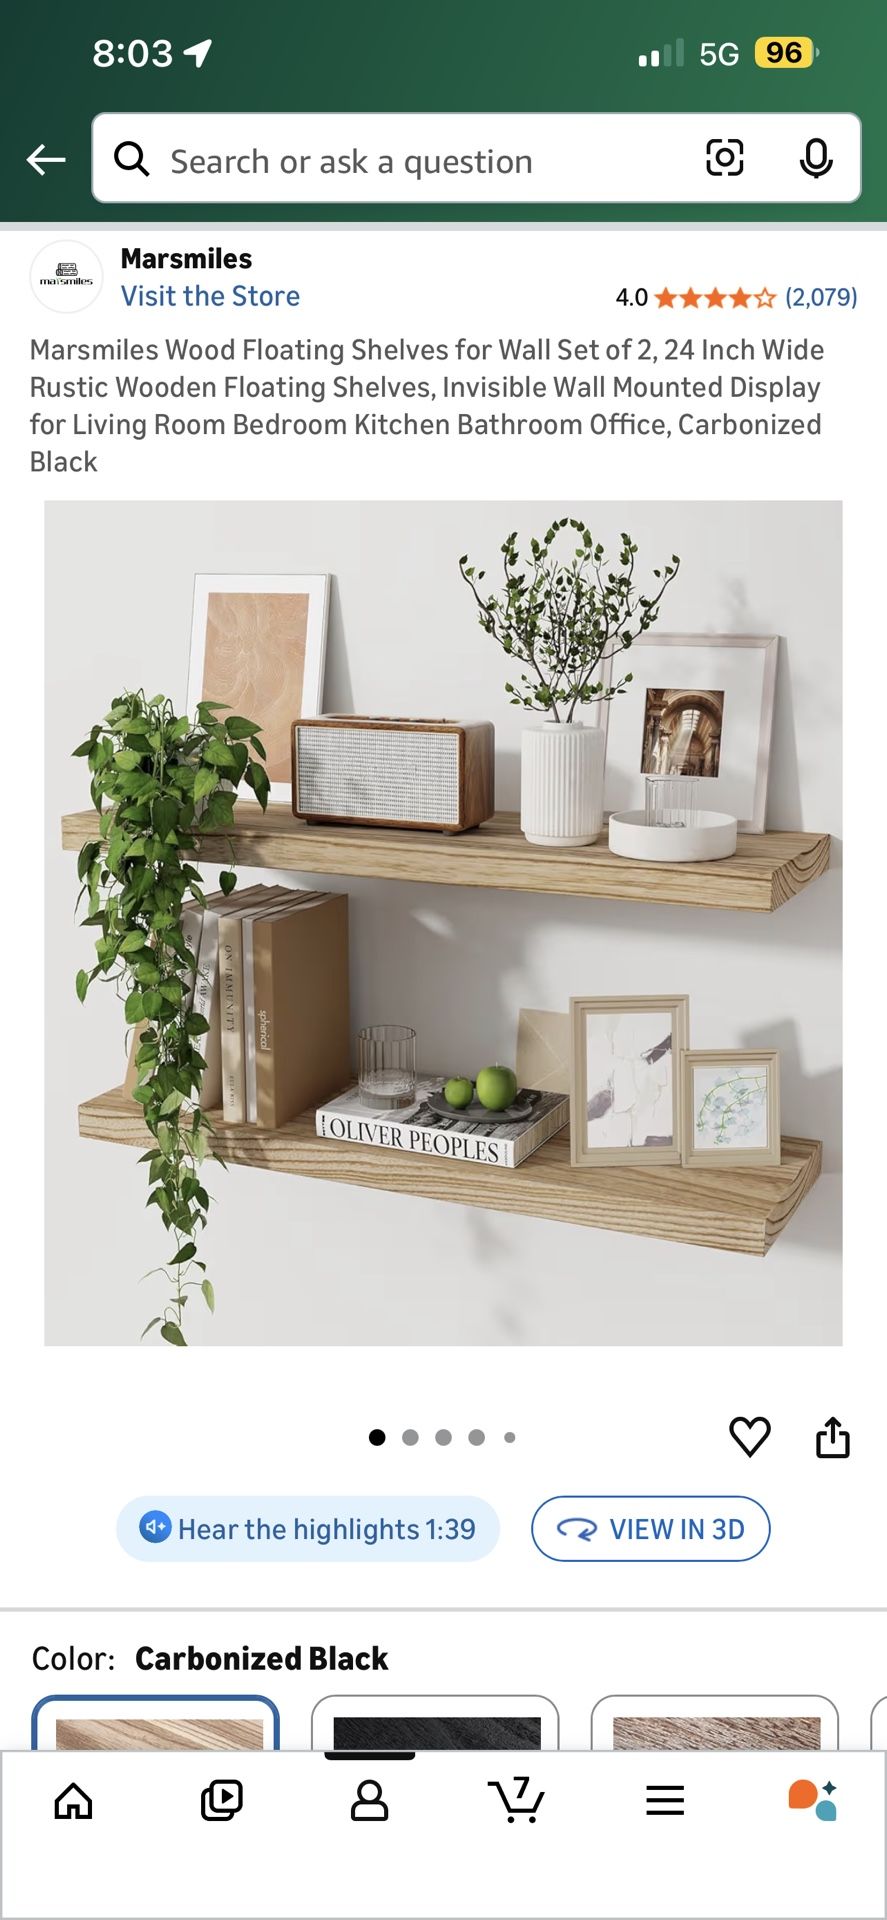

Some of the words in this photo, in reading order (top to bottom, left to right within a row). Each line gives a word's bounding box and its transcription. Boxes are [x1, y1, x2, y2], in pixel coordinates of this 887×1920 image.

[93, 39, 172, 67] 8:03
[700, 41, 740, 67] 5G
[765, 41, 803, 64] 96
[171, 147, 269, 175] Search
[280, 154, 312, 175] or
[320, 147, 369, 175] ask
[378, 154, 393, 175] a
[404, 148, 532, 181] question
[121, 246, 253, 270] Marsmiles
[39, 277, 94, 286] marsmiles
[120, 284, 177, 307] Visit
[182, 283, 225, 307] the
[232, 284, 301, 307] Store
[615, 287, 649, 307] 4.0
[785, 286, 858, 310] (2,079)
[30, 337, 159, 361] Marsmiles
[164, 337, 235, 361] Wood
[243, 337, 344, 366] Floating
[351, 337, 449, 361] Shelves
[454, 337, 493, 361] for
[498, 337, 550, 361] Wall
[557, 338, 600, 361] Set
[605, 337, 634, 361] of
[637, 338, 658, 365] 2,
[664, 338, 695, 361] 24
[702, 337, 755, 361] Inch
[761, 337, 825, 361] Wide
[30, 375, 108, 398] Rustic
[115, 375, 216, 398] Wooden
[224, 375, 326, 404] Floating
[333, 375, 437, 402] Shelves,
[443, 375, 547, 398] Invisible
[552, 375, 605, 398] Wall
[613, 375, 723, 398] Mounted
[731, 375, 821, 403] Display
[29, 412, 67, 436] for
[73, 413, 147, 441] Living
[155, 413, 225, 436] Room
[233, 412, 347, 436] Bedroom
[355, 412, 450, 436] Kitchen
[458, 412, 582, 436] Bathroom
[590, 412, 672, 439] Office,
[678, 412, 821, 436] Carbonized
[30, 449, 98, 473] Black
[224, 944, 233, 961] ON
[224, 967, 236, 1034] IMMUNITY
[257, 1009, 272, 1052] spherical
[329, 1116, 404, 1149] OLIVER
[409, 1129, 500, 1164] PEOPLES
[179, 1517, 240, 1541] Hear
[243, 1517, 287, 1541] the
[294, 1517, 420, 1546] highlights
[425, 1517, 476, 1541] 1:39
[609, 1518, 675, 1540] VIEW
[681, 1518, 705, 1540] IN
[712, 1517, 745, 1541] 3D
[32, 1644, 115, 1672] Color:
[135, 1644, 302, 1671] Carbonized
[309, 1644, 390, 1671] Black
[512, 1775, 530, 1799] 7
